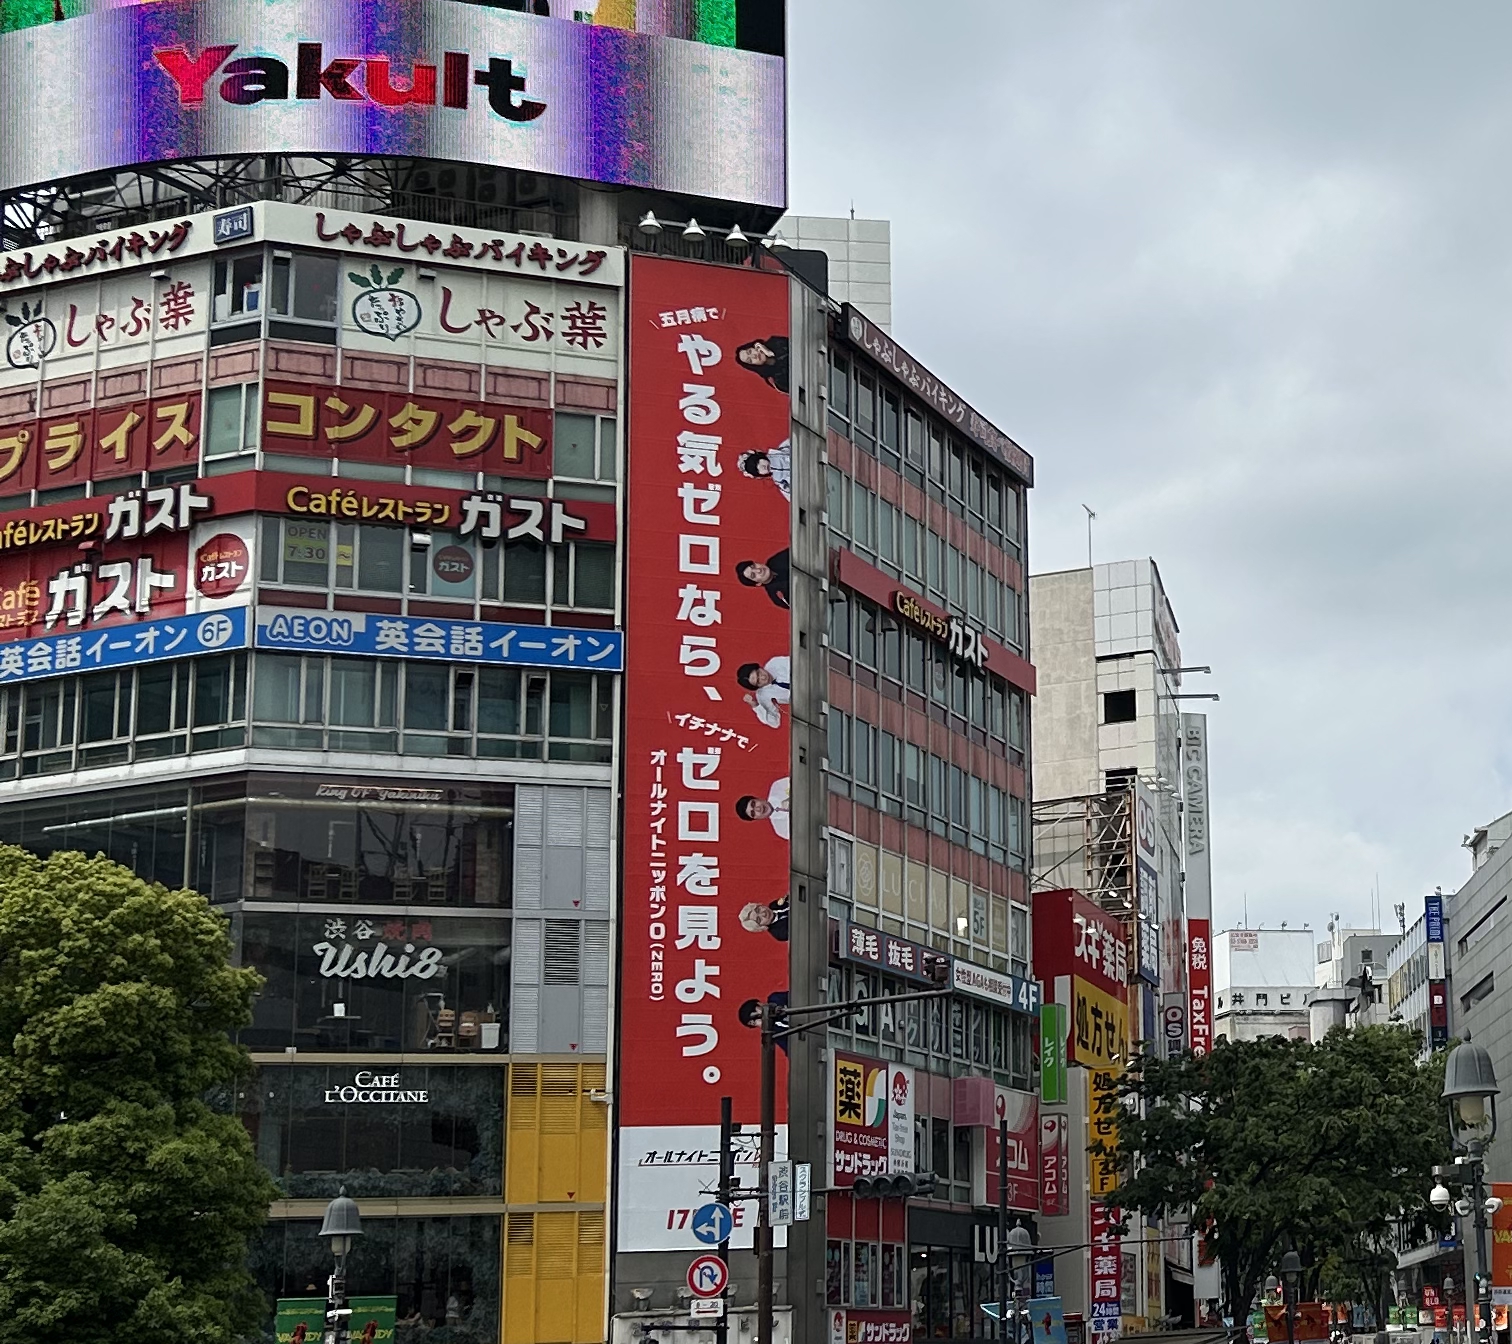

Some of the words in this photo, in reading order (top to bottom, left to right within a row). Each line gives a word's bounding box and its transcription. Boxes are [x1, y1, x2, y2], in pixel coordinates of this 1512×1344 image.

[152, 42, 548, 123] Yakult
[217, 213, 249, 237] 寿司
[316, 213, 607, 275] しゃぶしゃぶバイキング
[66, 281, 195, 348] しゃぶ葉
[441, 287, 609, 350] しゃぶ葉
[658, 307, 719, 328] 五月病で
[267, 392, 543, 460] コンタクト
[0, 513, 99, 550] féレストラン
[105, 484, 209, 541] ガスト
[287, 487, 449, 525] Caféレストラン
[460, 494, 585, 544] ガスト
[288, 527, 327, 540] OPEN
[677, 333, 722, 701] やる気ゼロなら、
[202, 562, 244, 582] ガスト
[0, 581, 41, 608] afé
[46, 558, 175, 630] ガスト
[0, 627, 188, 678] 英会話イーオン
[202, 621, 229, 642] 6F
[271, 620, 351, 644] AEON
[376, 622, 616, 662] 英会話イーオン
[949, 617, 989, 668] ガスト
[675, 711, 749, 749] イチナナで
[675, 747, 722, 1085] ゼロを見よう。
[313, 943, 443, 979] Ushi8
[852, 929, 879, 960] 薄毛
[888, 940, 914, 971] 抜毛
[1075, 912, 1128, 989] スギ薬局
[1191, 937, 1207, 970] 免税
[1018, 981, 1038, 1011] 4F
[1076, 1001, 1128, 1063] 処方せん
[1192, 986, 1210, 1058] TaxFre
[325, 1085, 428, 1103] L'OCCITANE
[355, 1071, 400, 1088] CAFÉ
[839, 1066, 861, 1119] 薬
[835, 1150, 887, 1176] サンドラッグ
[1044, 1156, 1057, 1194] アコム
[1007, 1182, 1018, 1202] 3F
[667, 1208, 745, 1229] 17E
[1093, 1303, 1105, 1317] 24
[866, 1322, 909, 1342] サンドラッグ
